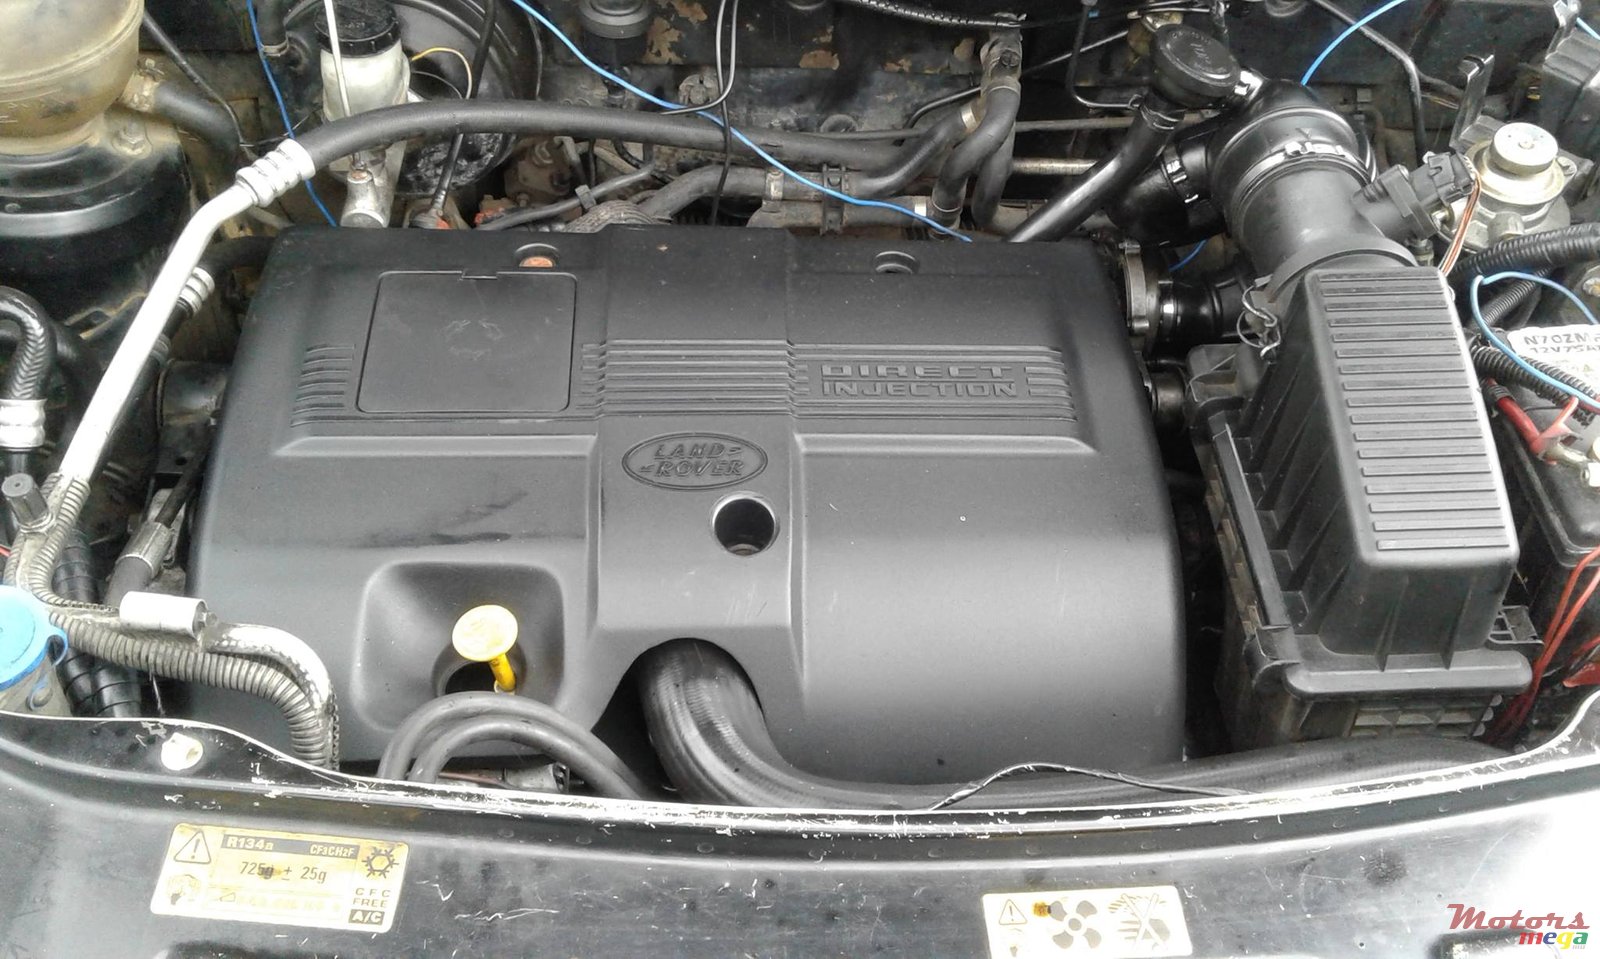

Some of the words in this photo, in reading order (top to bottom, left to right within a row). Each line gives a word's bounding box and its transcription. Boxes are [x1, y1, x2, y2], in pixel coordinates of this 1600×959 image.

[820, 364, 1012, 378] DIRECT
[822, 381, 1018, 397] INJECTION
[226, 836, 275, 851] R134a
[300, 866, 327, 884] 25g
[352, 897, 389, 909] FREE
[351, 910, 383, 923] A/C
